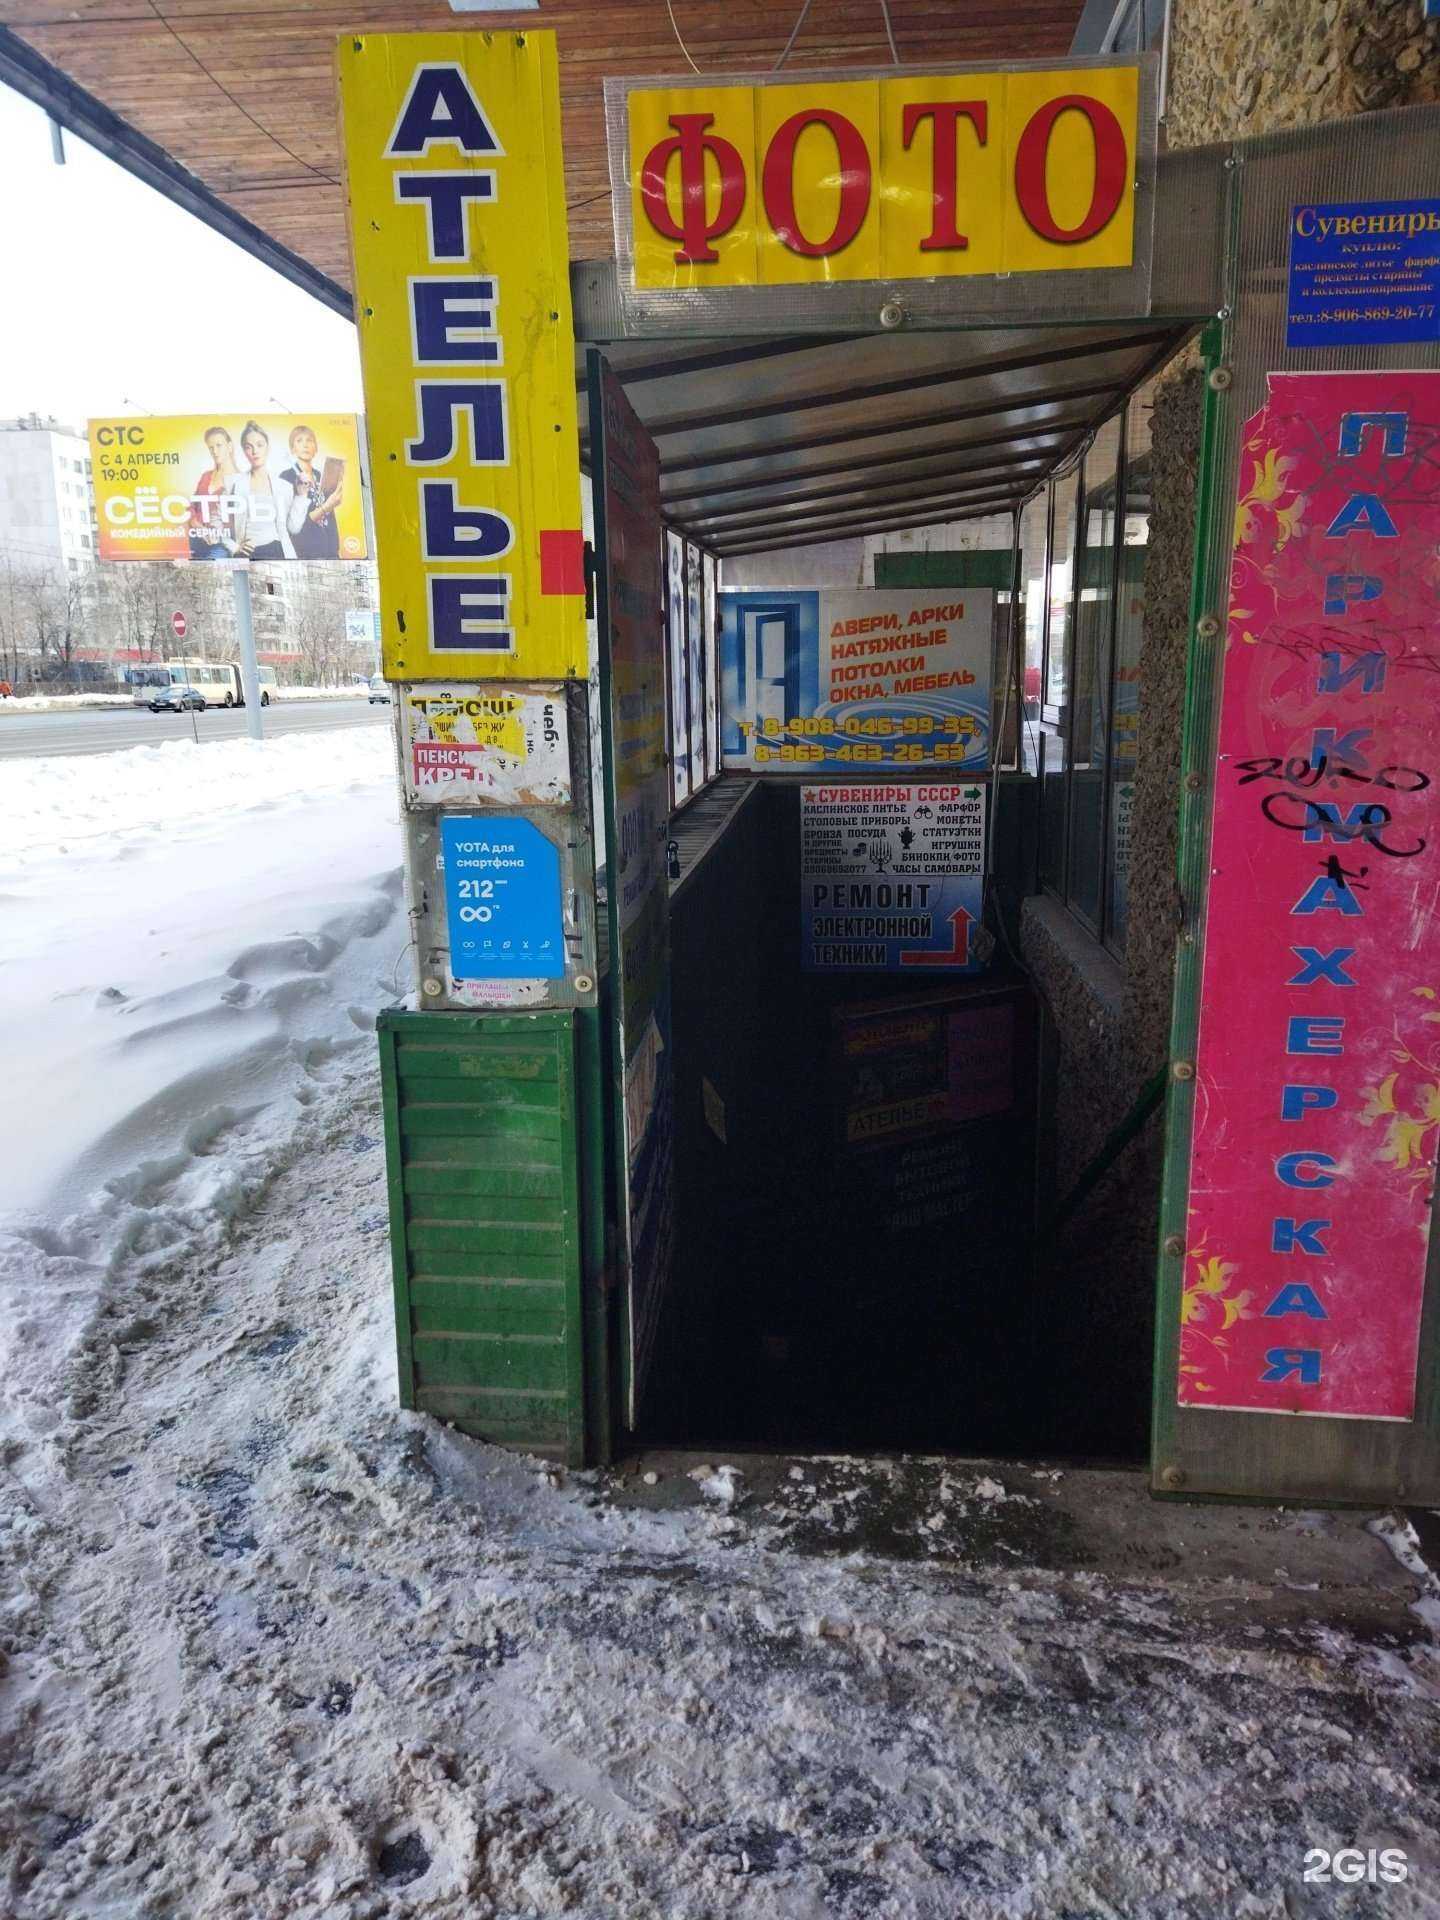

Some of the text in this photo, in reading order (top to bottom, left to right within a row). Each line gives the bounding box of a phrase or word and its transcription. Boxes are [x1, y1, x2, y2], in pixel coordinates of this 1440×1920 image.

[640, 94, 1128, 263] ФОТО
[382, 61, 516, 655] АТЕЛЬЕ
[96, 425, 145, 447] СТС
[100, 452, 180, 466] С 4 АПРЕЛЯ
[101, 468, 139, 482] 19:00
[104, 486, 282, 525] СЁСТРЫ
[110, 526, 232, 540] КОМЕДИЙНЫЙ СЕРИАЛ
[831, 603, 964, 638] ДВЕРИ, АРКИ
[831, 628, 948, 660] НАТЯЖНЫЕ
[831, 656, 925, 684] ПОТОЛКИ
[829, 669, 976, 704] ОКНА, МЕБЕЛЬ
[818, 786, 961, 804] СУВЕНИРЫ СССР
[803, 803, 908, 815] КАСЛИНСКОЕ ЛИТЬЕ
[938, 803, 981, 814] ФАРФОР
[803, 815, 911, 827] СТОЛОВЫЕ ПРИБОРЫ
[936, 815, 982, 826] МОНЕТЫ
[803, 828, 887, 840] БРОНЗА ПОСУДА
[922, 827, 982, 838] СТАТУЭТКИ
[455, 842, 515, 855] YOTA для
[931, 840, 981, 851] ИГРУШКИ
[456, 857, 525, 870] смартфона
[953, 851, 981, 862] ФОТО
[892, 863, 981, 875] ЧАСЫ САМОВАРЫ
[458, 879, 494, 898] 212
[812, 884, 931, 910] РЕМОНТ
[1259, 411, 1410, 1385] ПАРИКМАХЕРСКАЯ
[812, 912, 933, 939] ЭЛЕКТРОННОЙ
[813, 943, 888, 966] ТЕХНИКИ
